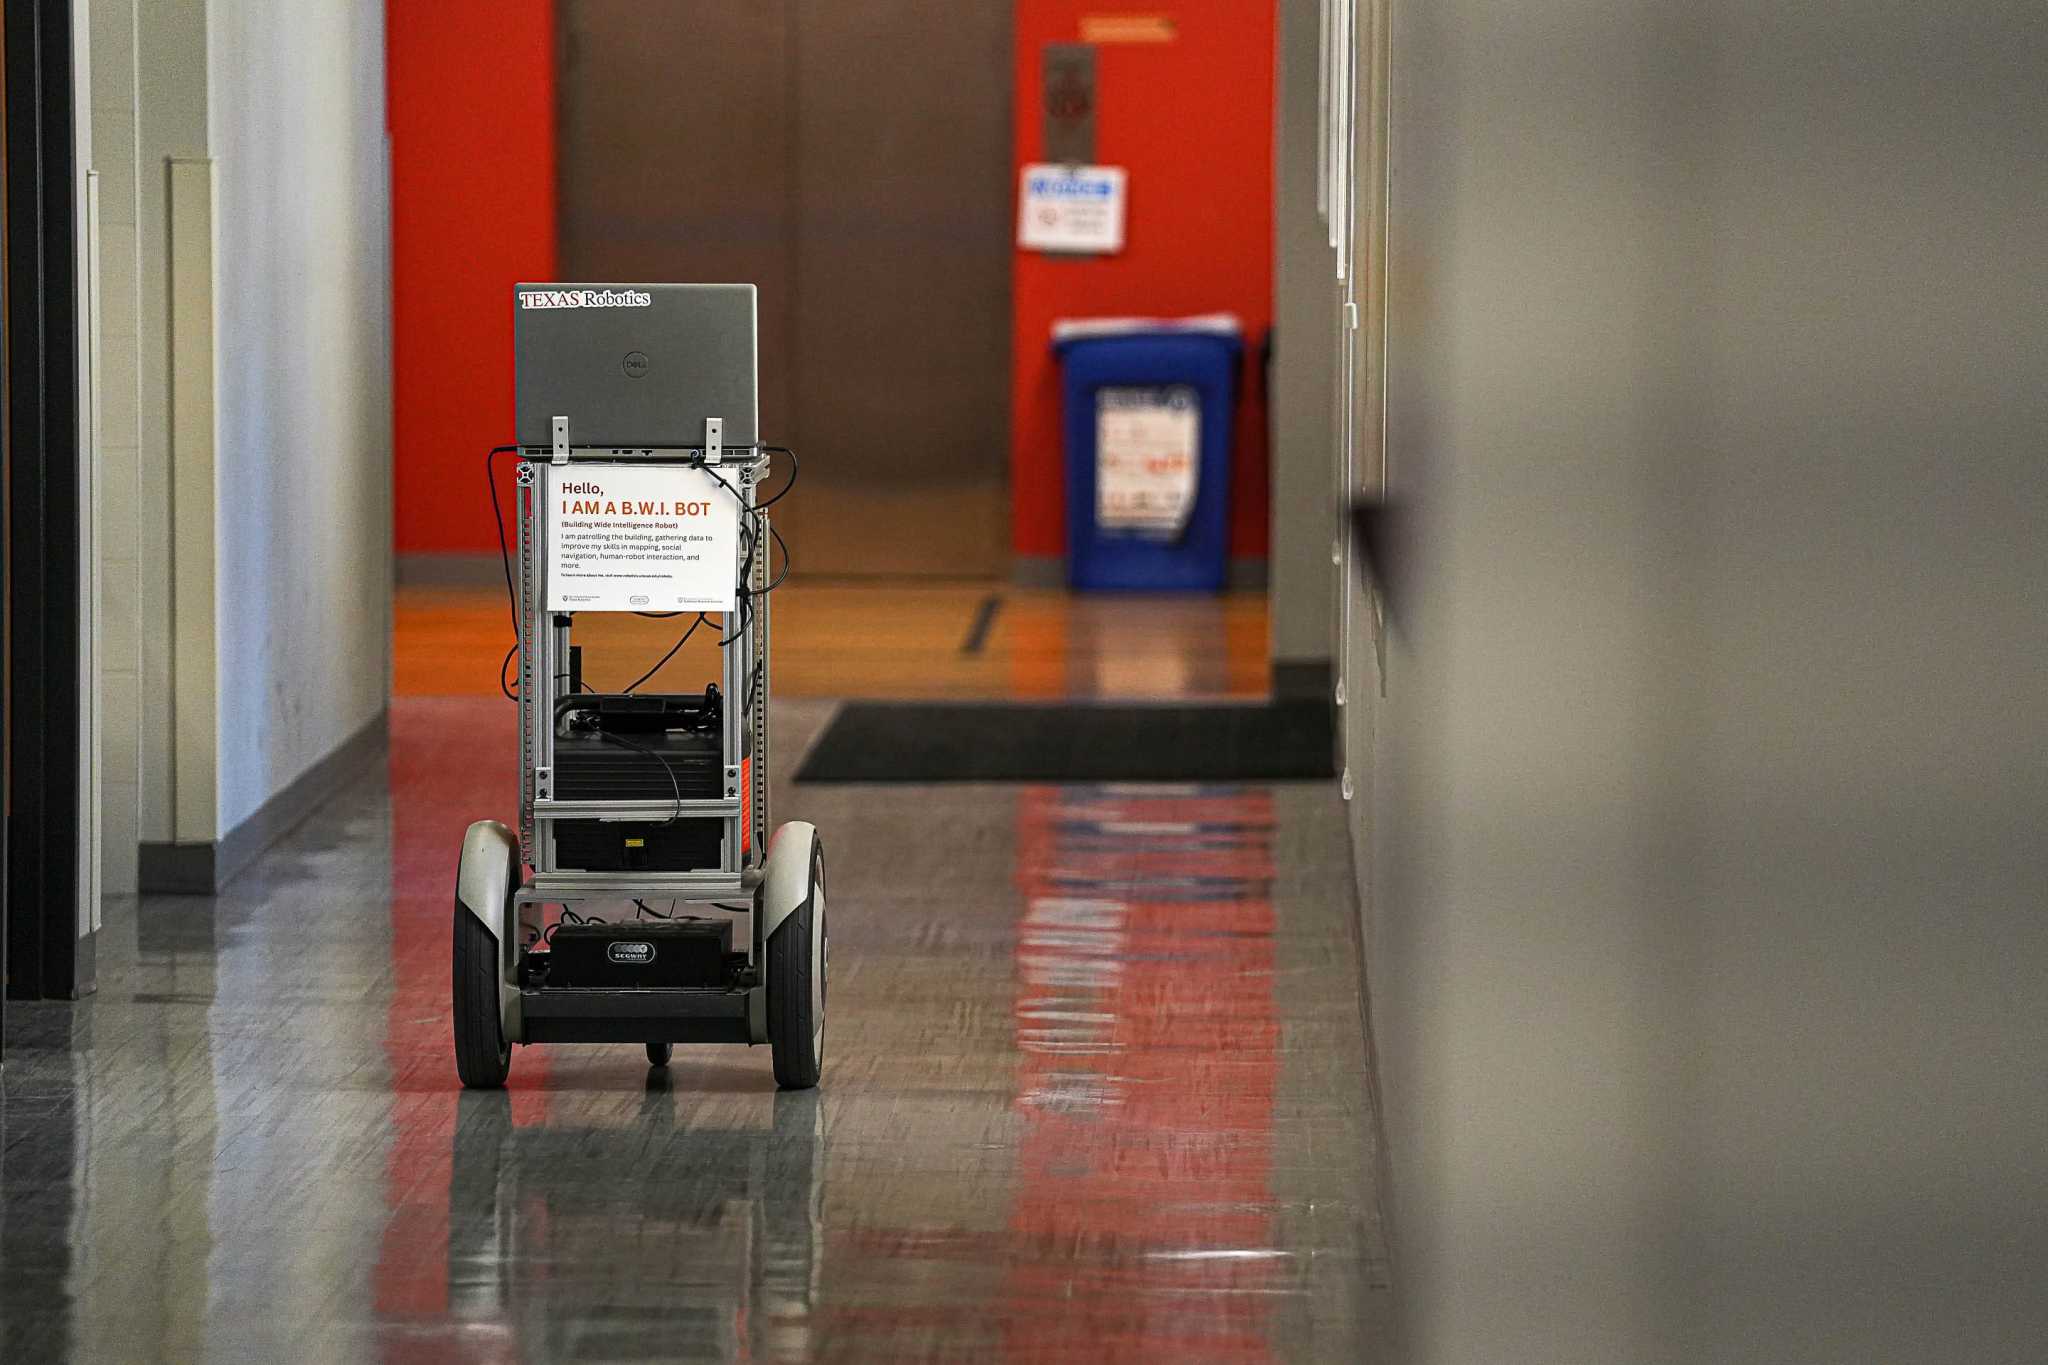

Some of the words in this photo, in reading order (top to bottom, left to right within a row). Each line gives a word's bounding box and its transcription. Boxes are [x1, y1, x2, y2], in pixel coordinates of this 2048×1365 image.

[520, 293, 580, 307] TEXAS
[585, 291, 649, 306] Robotics
[562, 482, 604, 496] Hello,
[562, 501, 566, 514] I
[572, 501, 599, 514] AM
[604, 501, 616, 514] A
[622, 502, 670, 516] B.W.I.
[675, 502, 711, 516] BOT
[562, 521, 592, 529] (Building
[577, 534, 610, 542] patrolling
